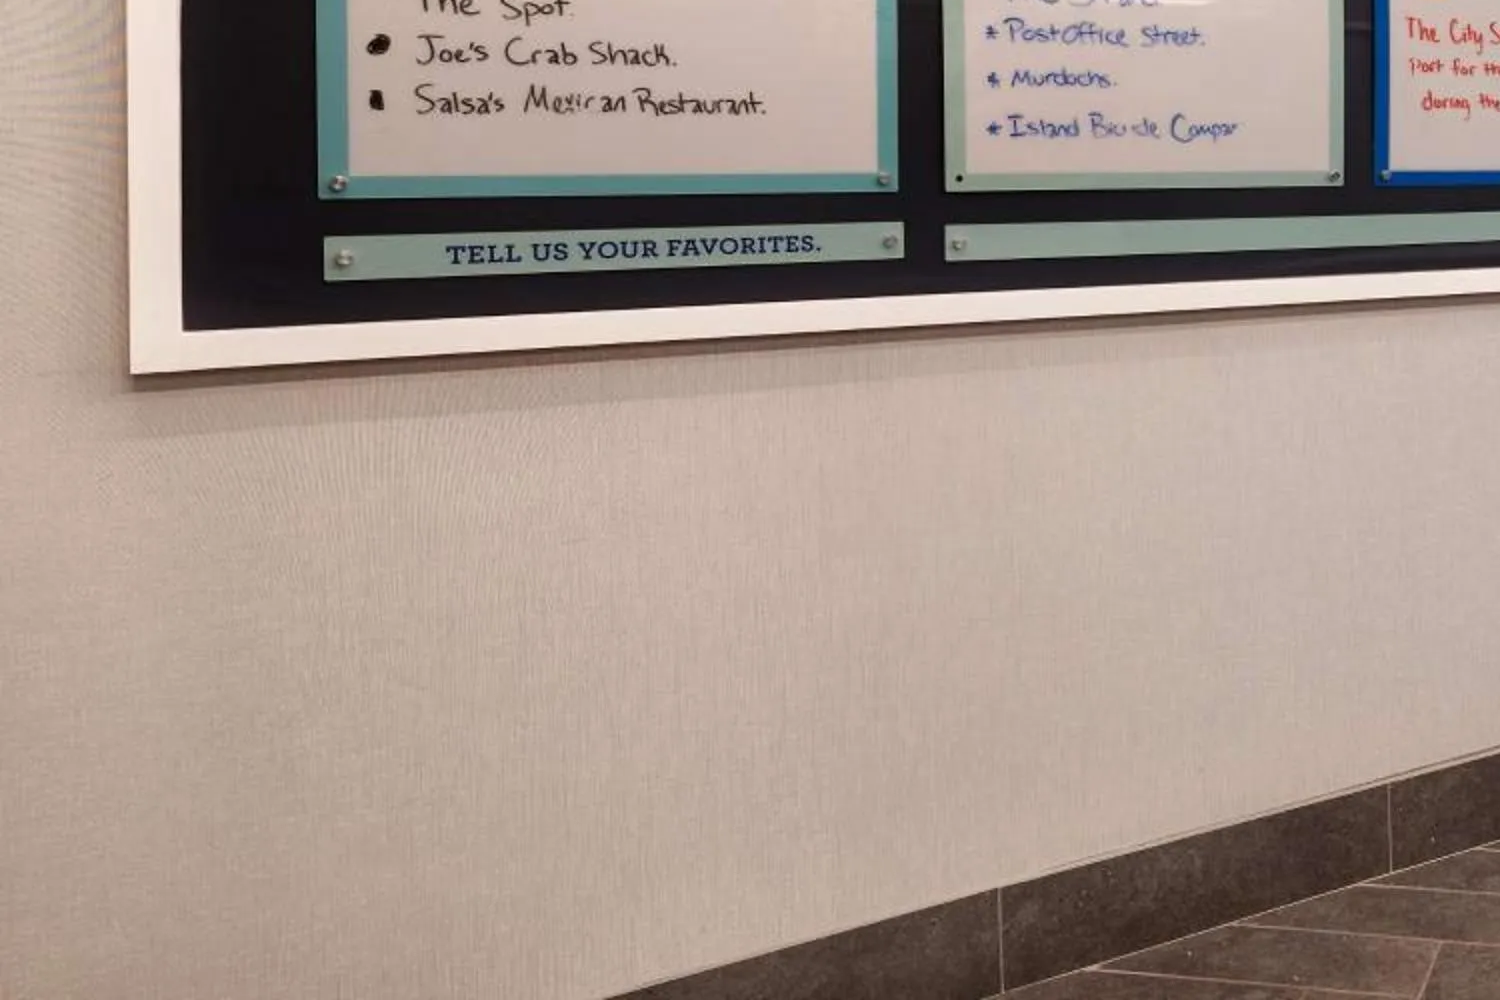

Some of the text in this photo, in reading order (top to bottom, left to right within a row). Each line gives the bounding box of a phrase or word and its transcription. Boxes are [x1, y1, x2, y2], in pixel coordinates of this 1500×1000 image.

[416, 34, 678, 67] Joe's Crab Shack.
[1405, 16, 1441, 44] The
[1449, 18, 1484, 55] City
[1451, 57, 1476, 77] for
[414, 83, 505, 116] Salsa's
[631, 87, 767, 117] Restaurant.
[1479, 92, 1500, 112] the
[1007, 113, 1080, 140] Island
[446, 234, 822, 266] TELL US YOUR FAVORITES.
